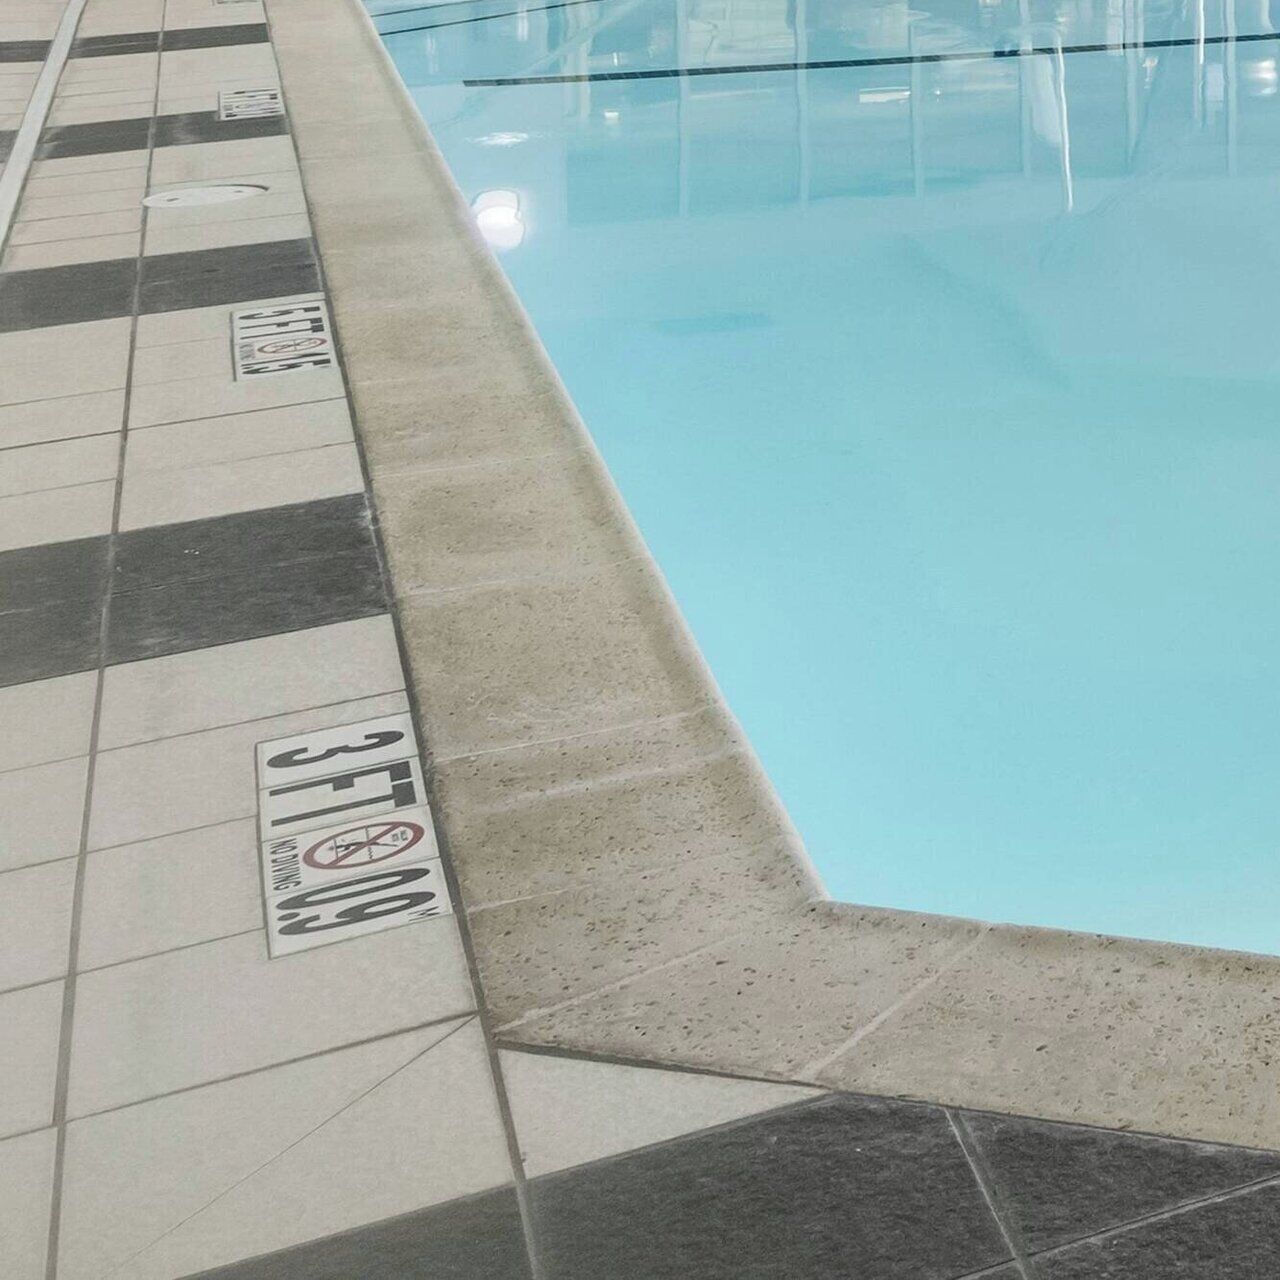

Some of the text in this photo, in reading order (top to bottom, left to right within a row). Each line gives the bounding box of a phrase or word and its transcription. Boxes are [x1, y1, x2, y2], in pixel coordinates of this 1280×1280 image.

[239, 306, 320, 320] 5
[240, 317, 325, 340] FT
[266, 730, 405, 768] 3
[269, 760, 417, 827] FT
[270, 837, 302, 892] NO DIVING
